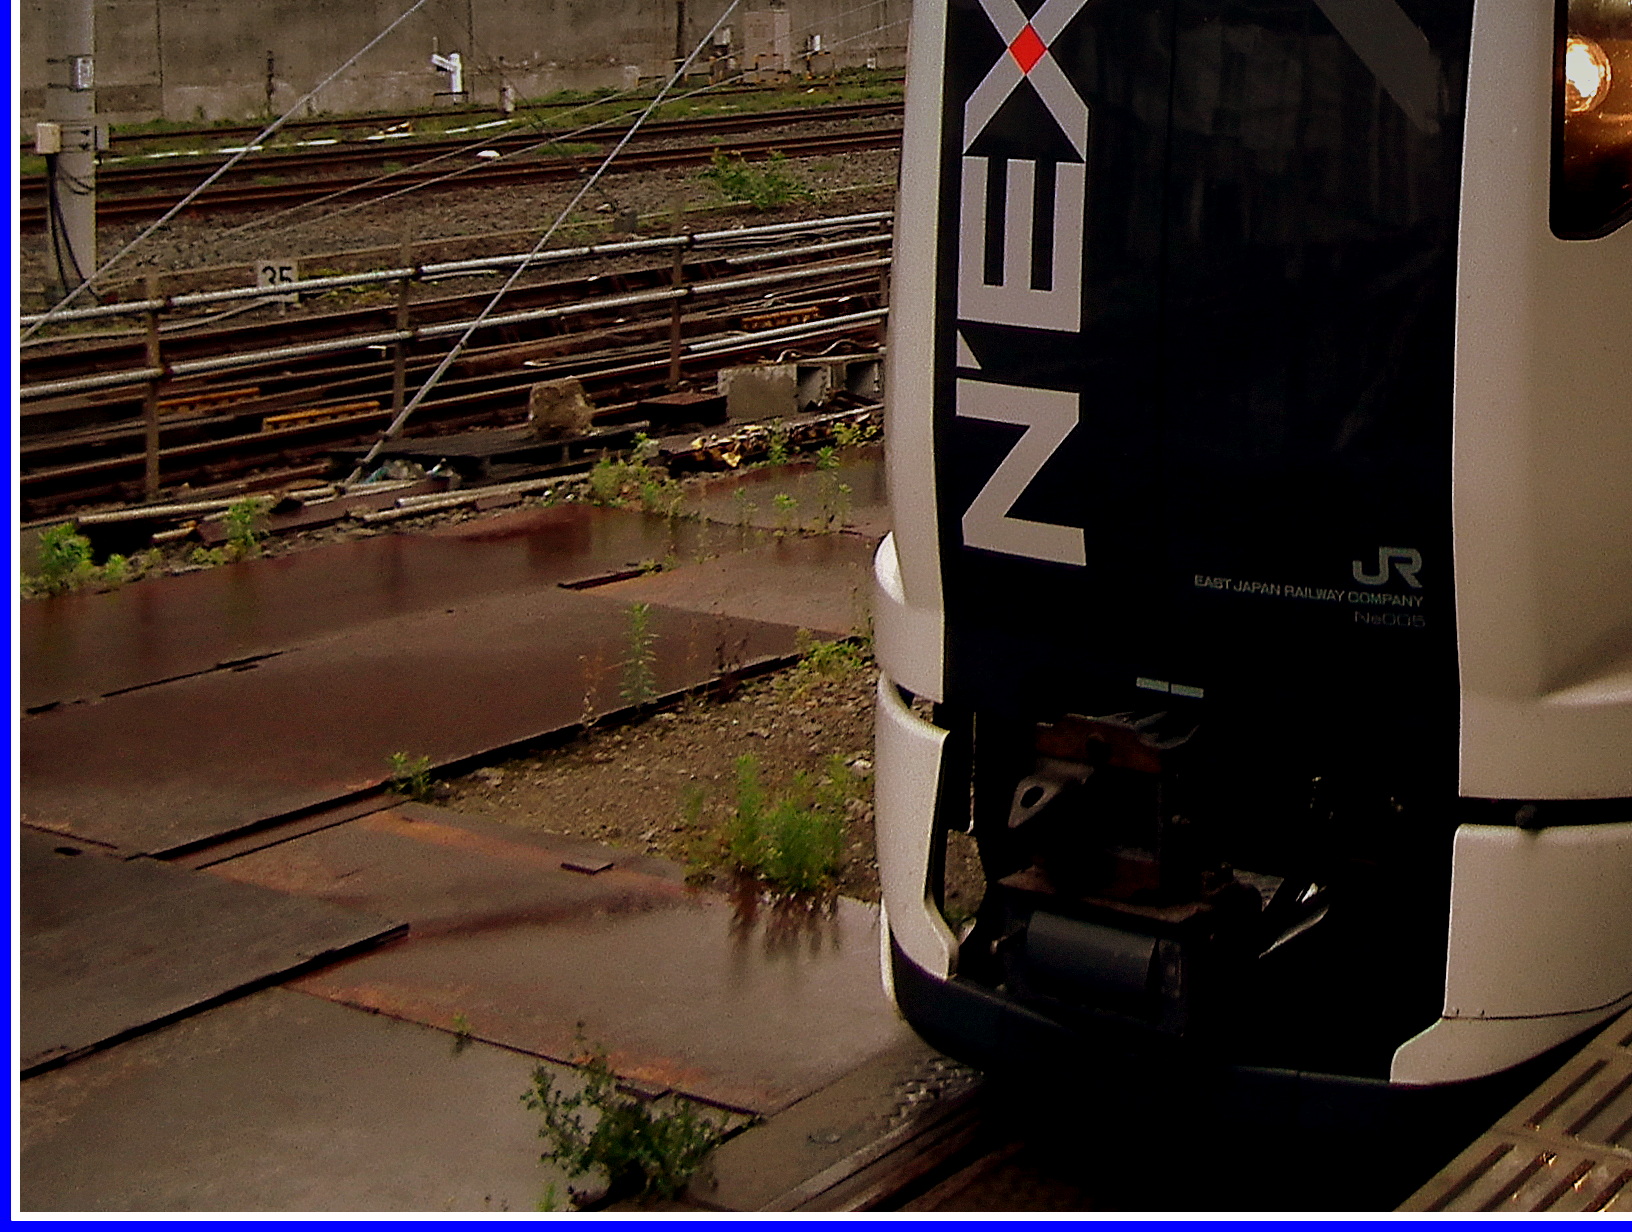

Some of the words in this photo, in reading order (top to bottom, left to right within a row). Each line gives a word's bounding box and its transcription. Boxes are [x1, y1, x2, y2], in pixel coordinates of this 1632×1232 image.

[1352, 545, 1423, 588] JR
[1194, 574, 1232, 590] EAST
[1233, 579, 1281, 596] JAPAN
[1284, 584, 1345, 603] RAILWAY
[1348, 590, 1424, 608] COMPANY
